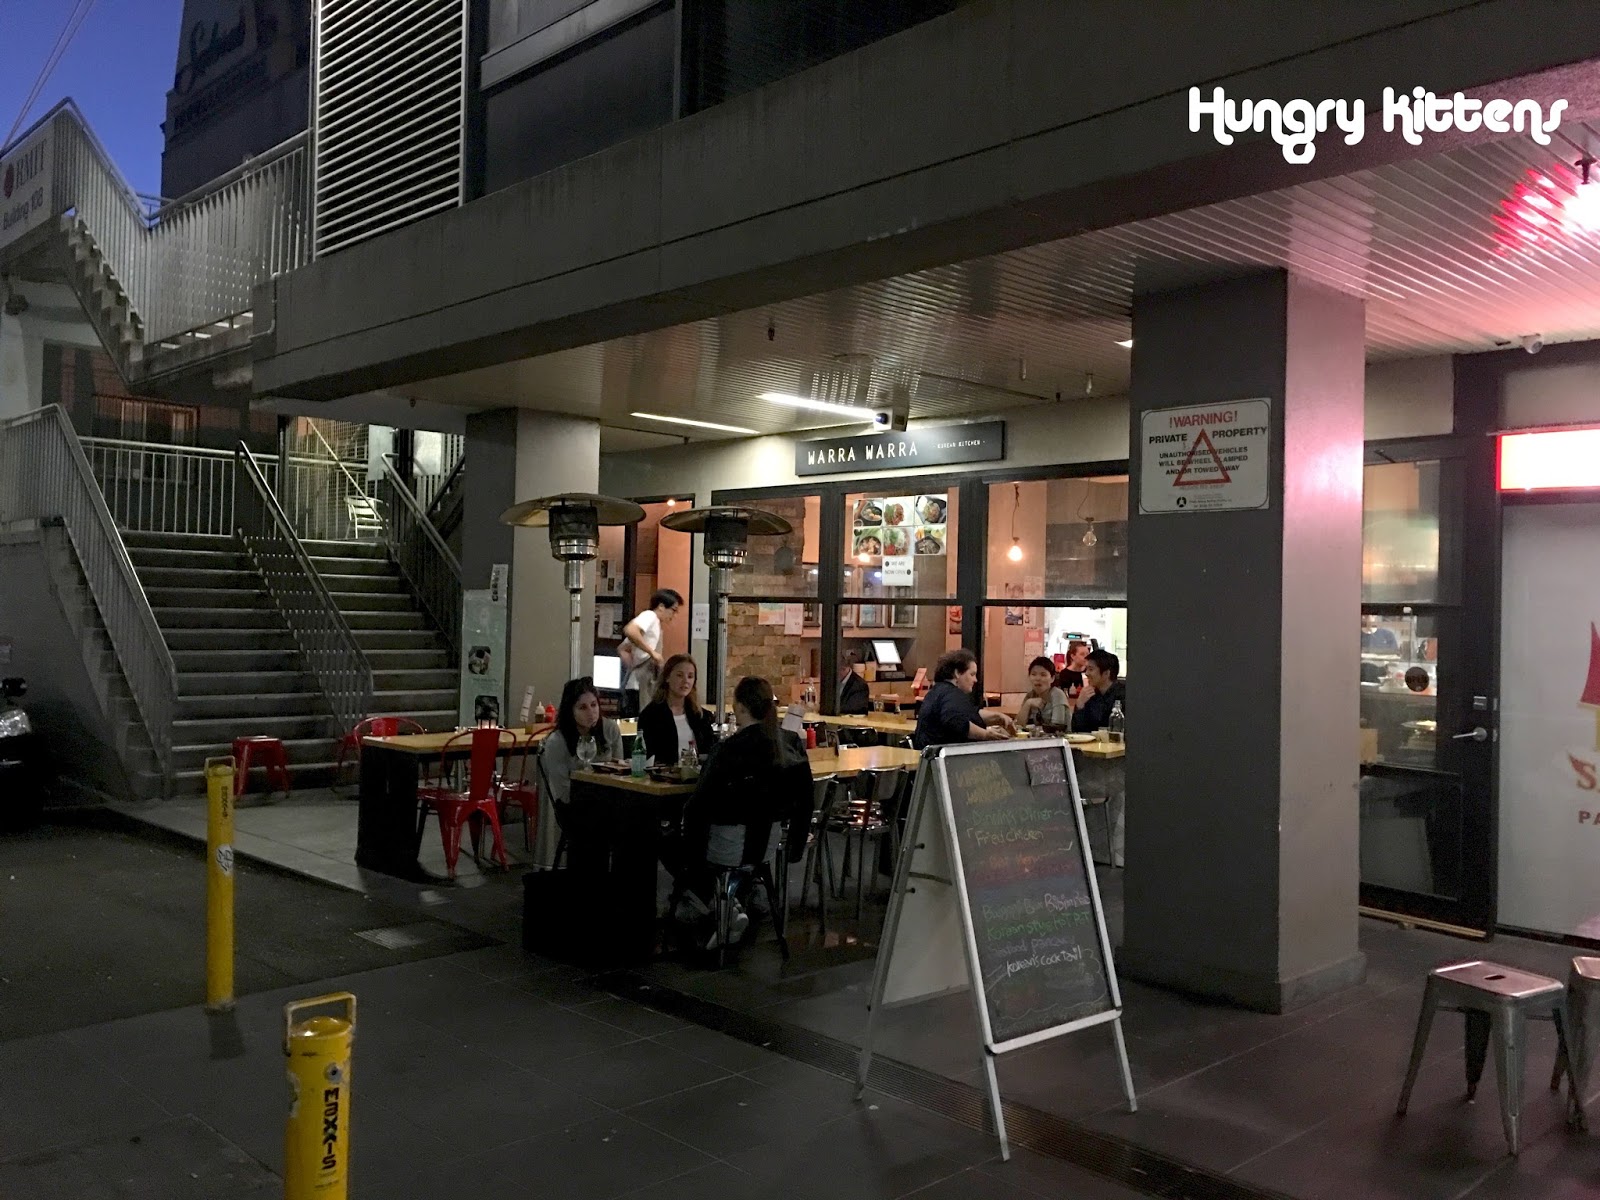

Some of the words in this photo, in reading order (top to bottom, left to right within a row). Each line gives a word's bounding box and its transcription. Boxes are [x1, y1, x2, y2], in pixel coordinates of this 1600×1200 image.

[16, 138, 46, 190] RMIT
[1149, 433, 1188, 444] PRIVATE
[1212, 427, 1268, 439] PROPERTY
[807, 446, 856, 466] WARRA
[866, 441, 918, 461] WARRA
[958, 439, 981, 447] KITCHEN
[1215, 446, 1248, 456] VEHICLES
[1187, 457, 1211, 465] WHEEL
[1215, 455, 1248, 463] CLAMPED
[1194, 466, 1219, 474] TOWED
